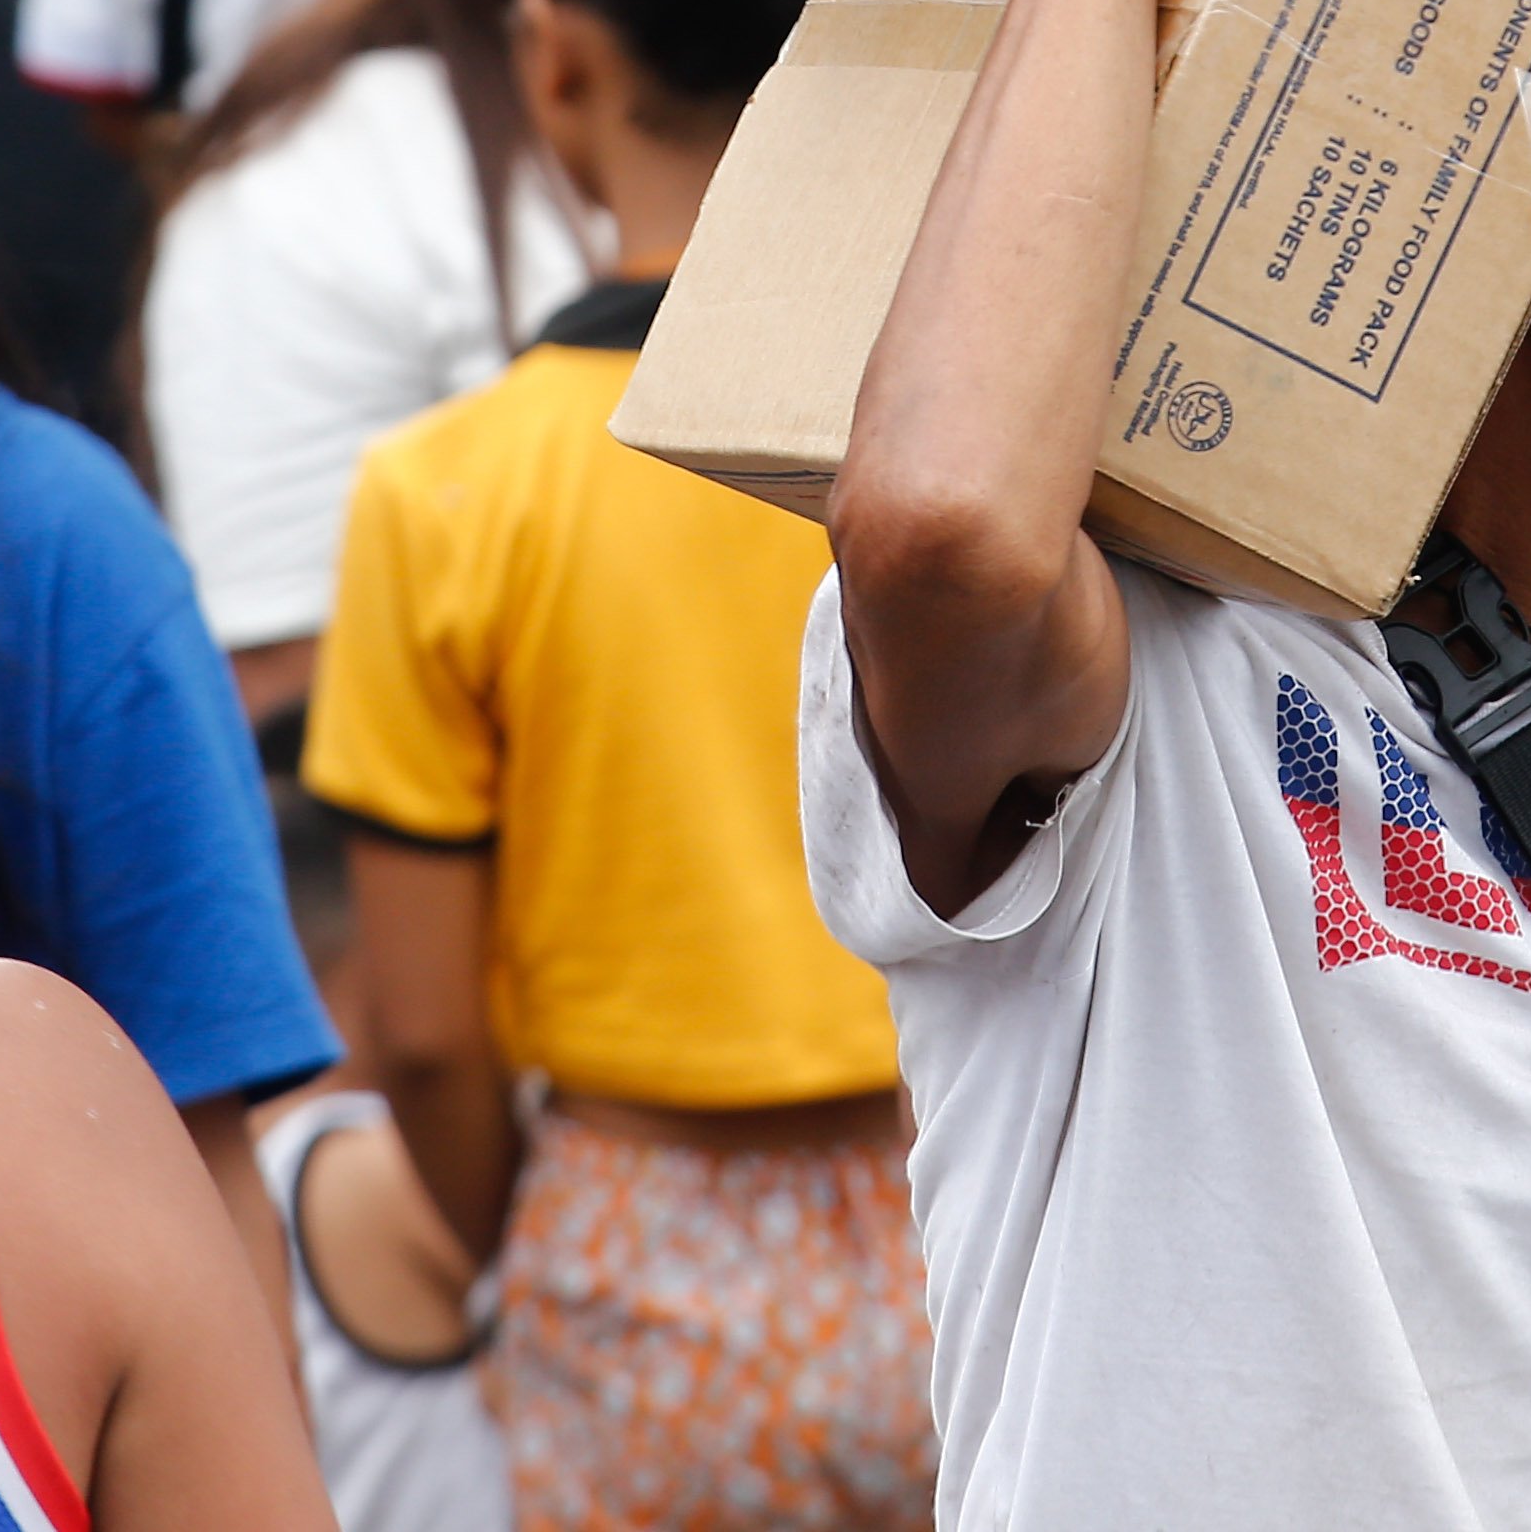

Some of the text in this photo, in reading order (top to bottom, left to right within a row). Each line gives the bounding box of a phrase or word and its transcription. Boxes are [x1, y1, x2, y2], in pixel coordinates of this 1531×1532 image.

[1463, 95, 1489, 132] OF
[1321, 136, 1346, 163] 10
[1347, 149, 1372, 176] 10
[1378, 159, 1398, 176] 6
[1419, 134, 1471, 224] FAMILY
[1265, 165, 1332, 282] SACHETS
[1319, 181, 1359, 236] TINS
[1309, 177, 1390, 327] KILOGRAMS
[1384, 223, 1429, 296] FOOD
[1349, 298, 1395, 369] PACK
[1141, 360, 1183, 437] Halal Certified
